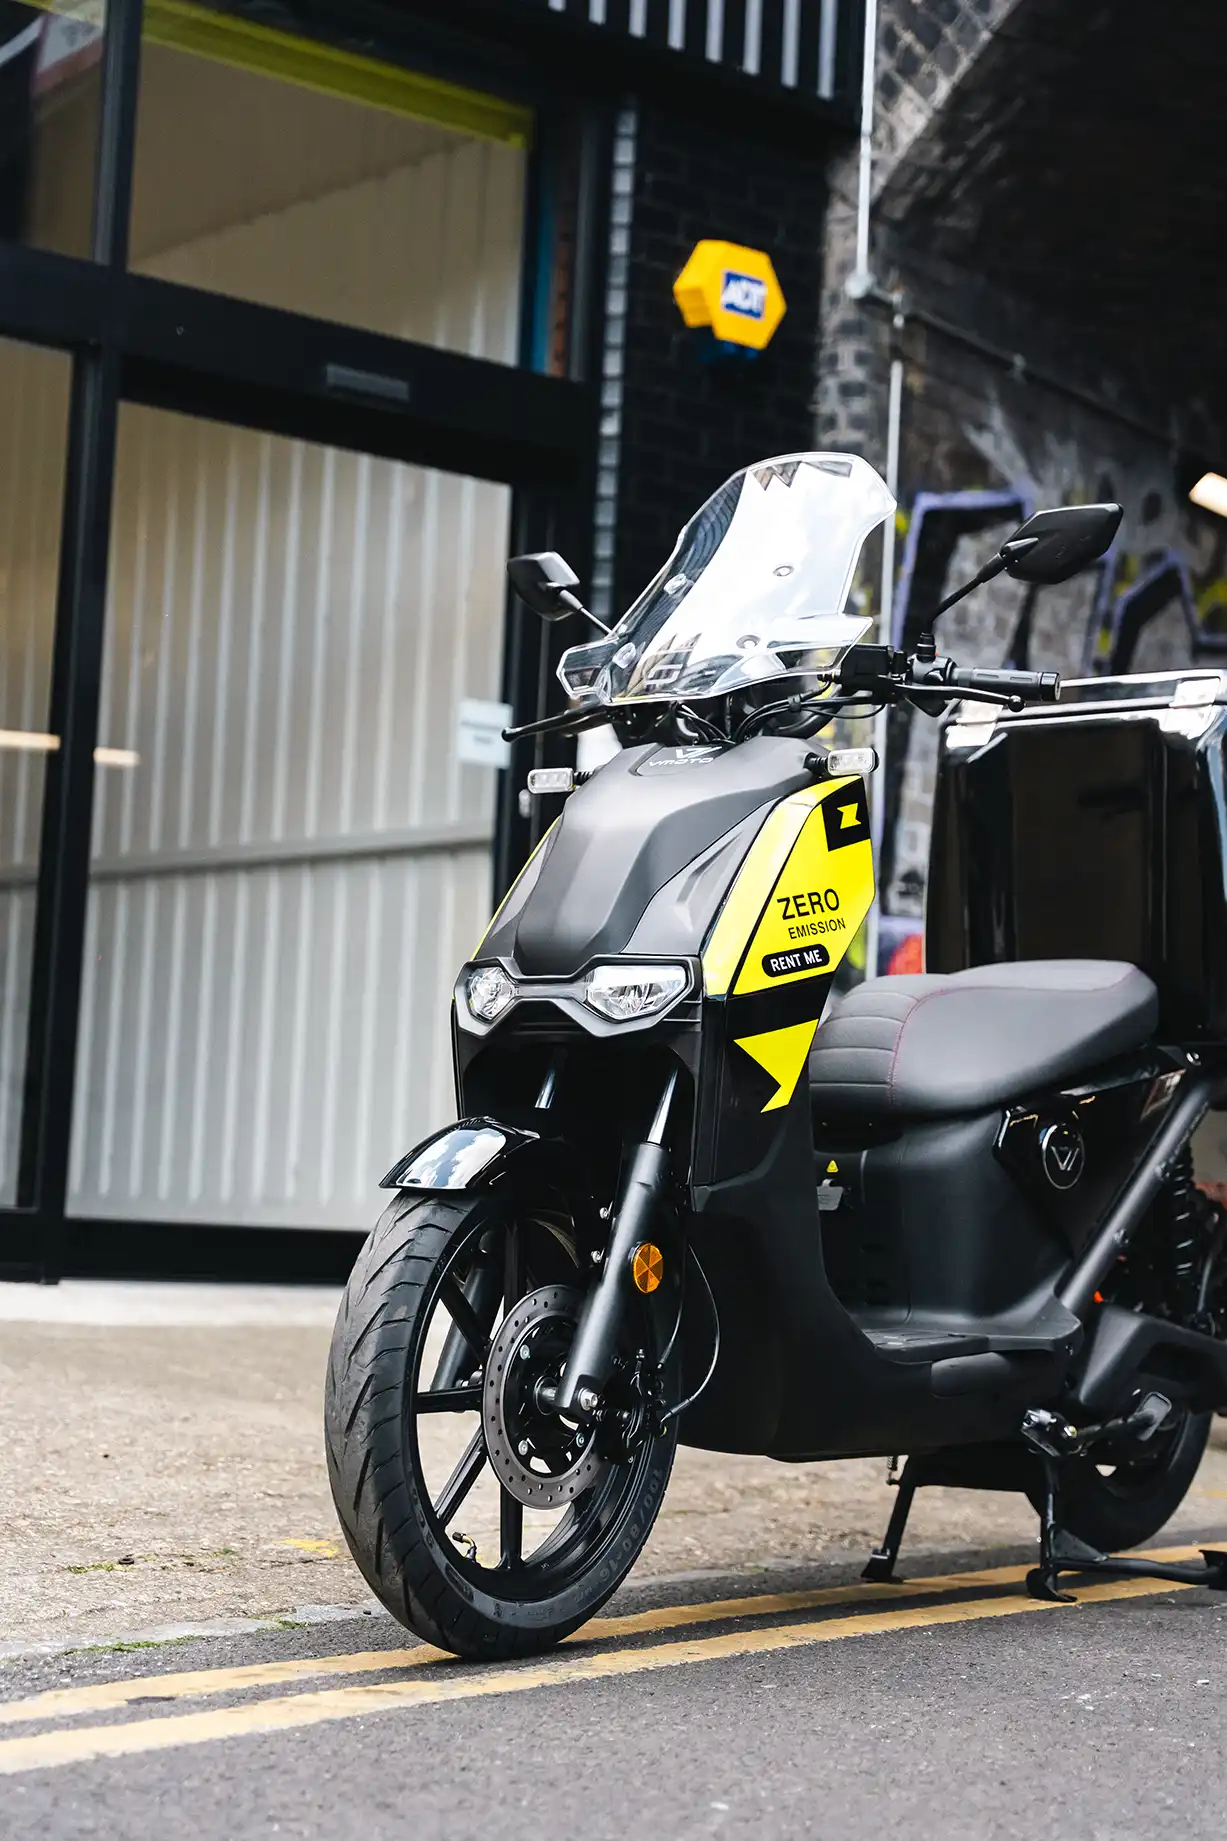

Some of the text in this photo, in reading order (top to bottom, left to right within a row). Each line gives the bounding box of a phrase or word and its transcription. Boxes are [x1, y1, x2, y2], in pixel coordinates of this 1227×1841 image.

[720, 278, 768, 314] ADT
[777, 888, 840, 920] ZERO
[788, 918, 846, 940] EMISSION
[769, 949, 823, 972] RENT ME
